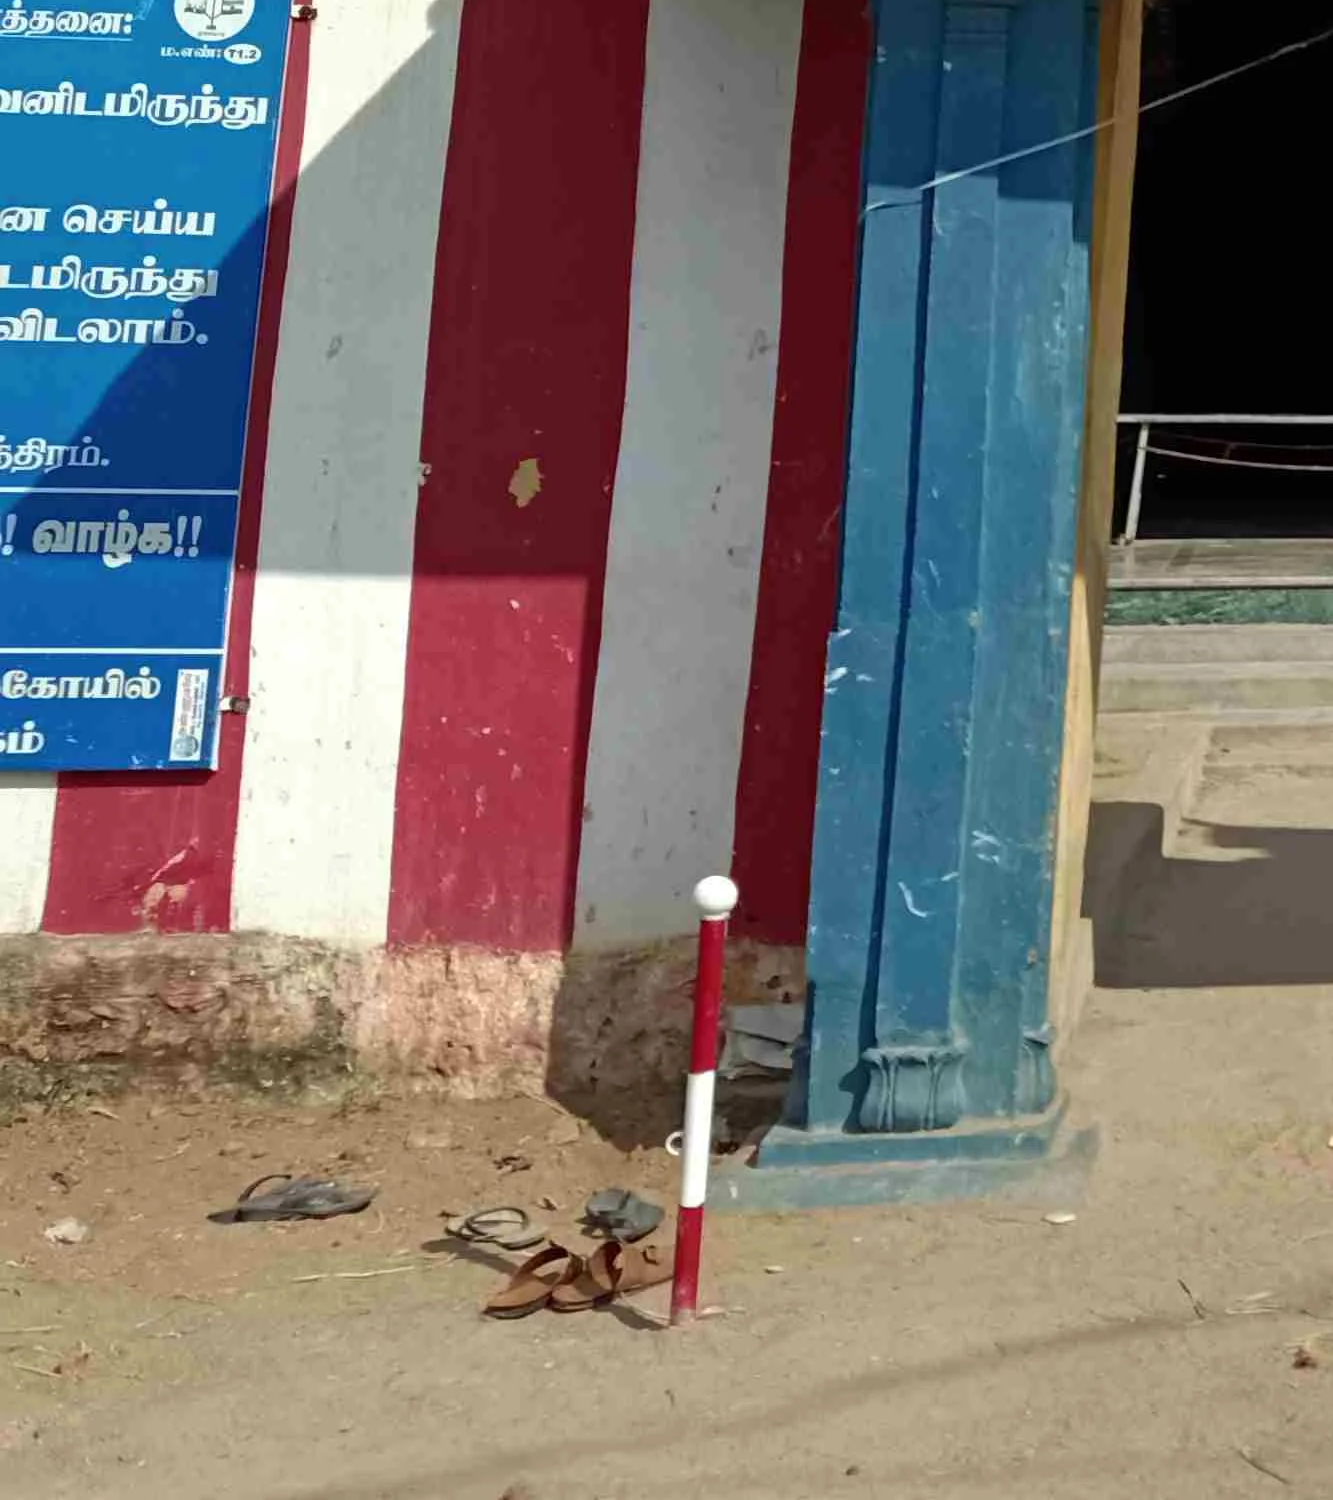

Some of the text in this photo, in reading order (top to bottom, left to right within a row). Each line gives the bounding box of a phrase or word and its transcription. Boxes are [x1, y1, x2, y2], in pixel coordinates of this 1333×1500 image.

[63, 198, 216, 236] செய்ய
[32, 509, 202, 568] வாழ்க!!
[2, 666, 161, 699] கோயில்
